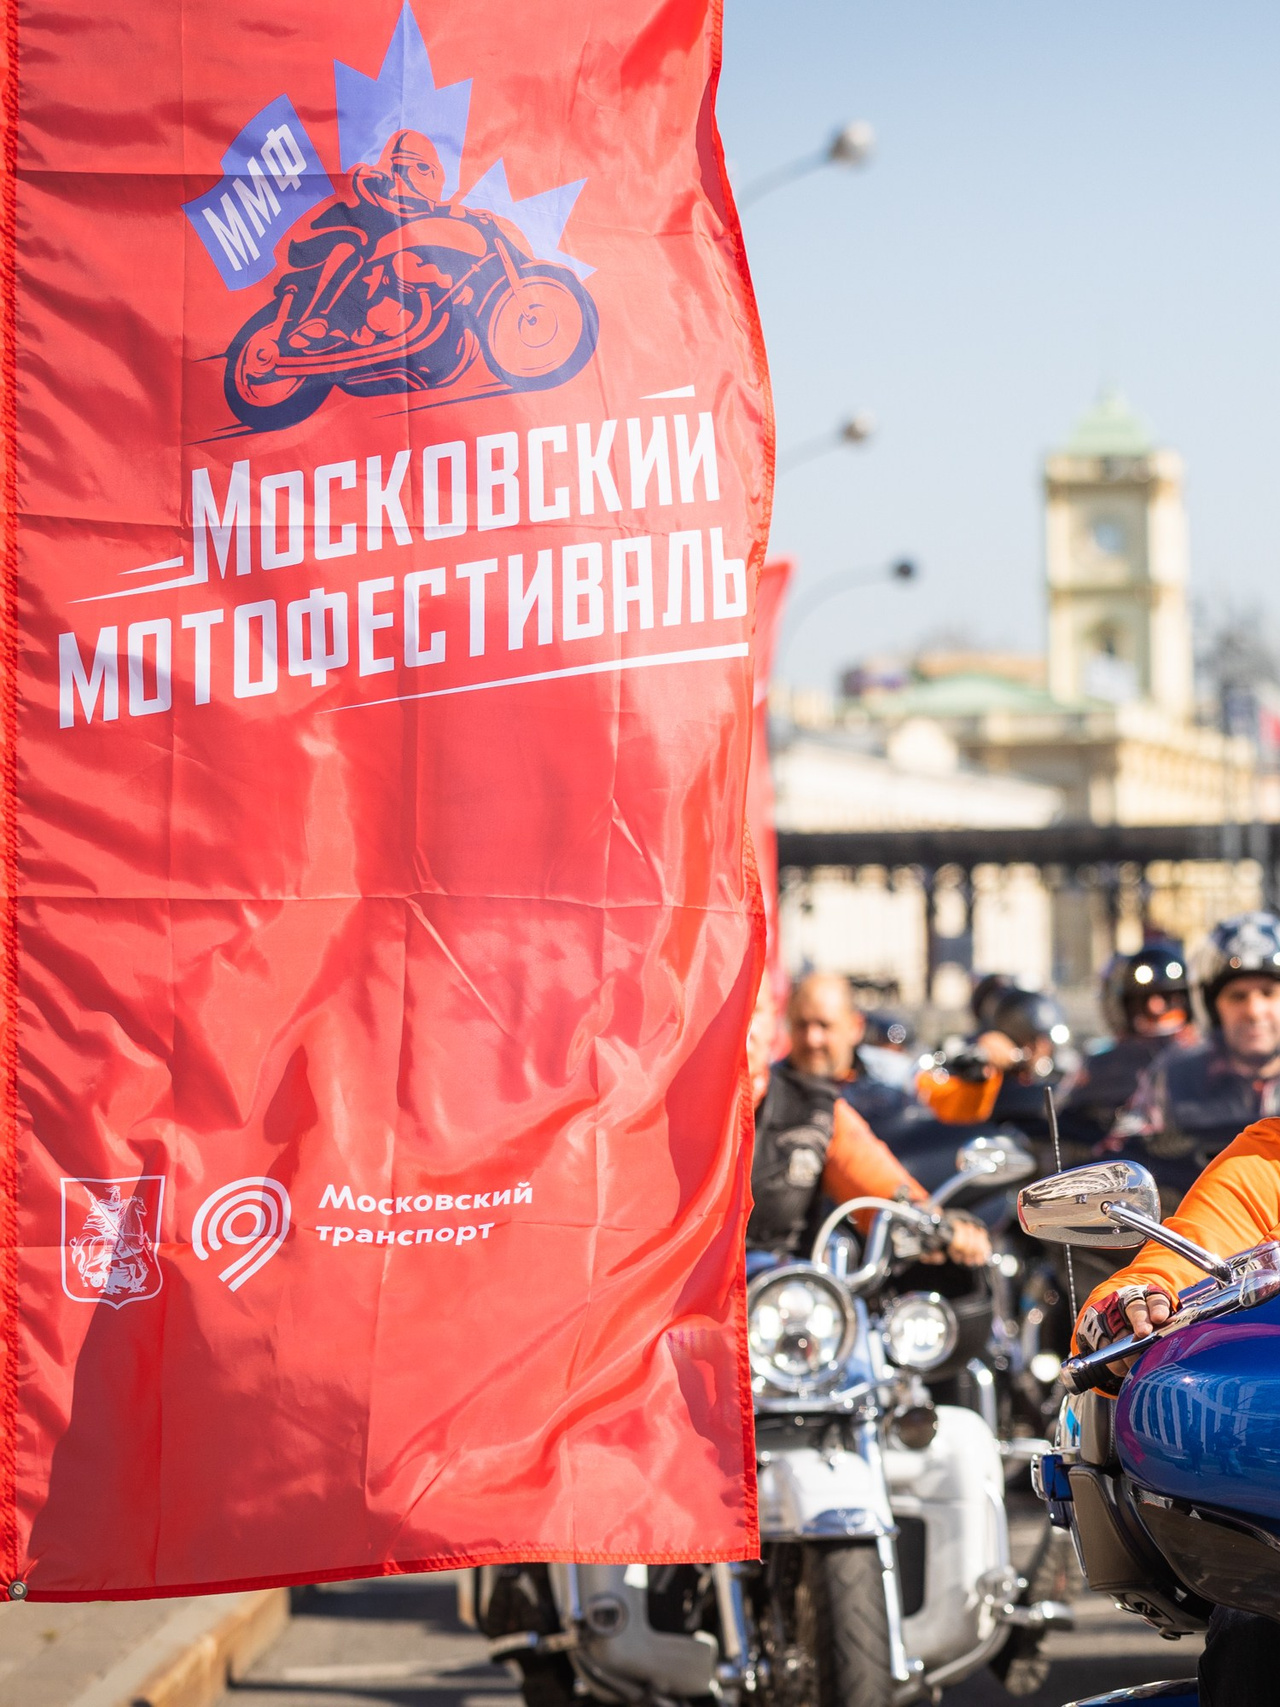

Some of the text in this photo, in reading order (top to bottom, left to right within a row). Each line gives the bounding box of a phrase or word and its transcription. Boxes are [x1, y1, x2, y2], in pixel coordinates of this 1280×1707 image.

[201, 123, 307, 272] ММФ
[58, 526, 748, 729] МОТОФЕСТИВАЛЬ
[315, 1222, 496, 1247] транспорт
[318, 1181, 534, 1216] Московский
